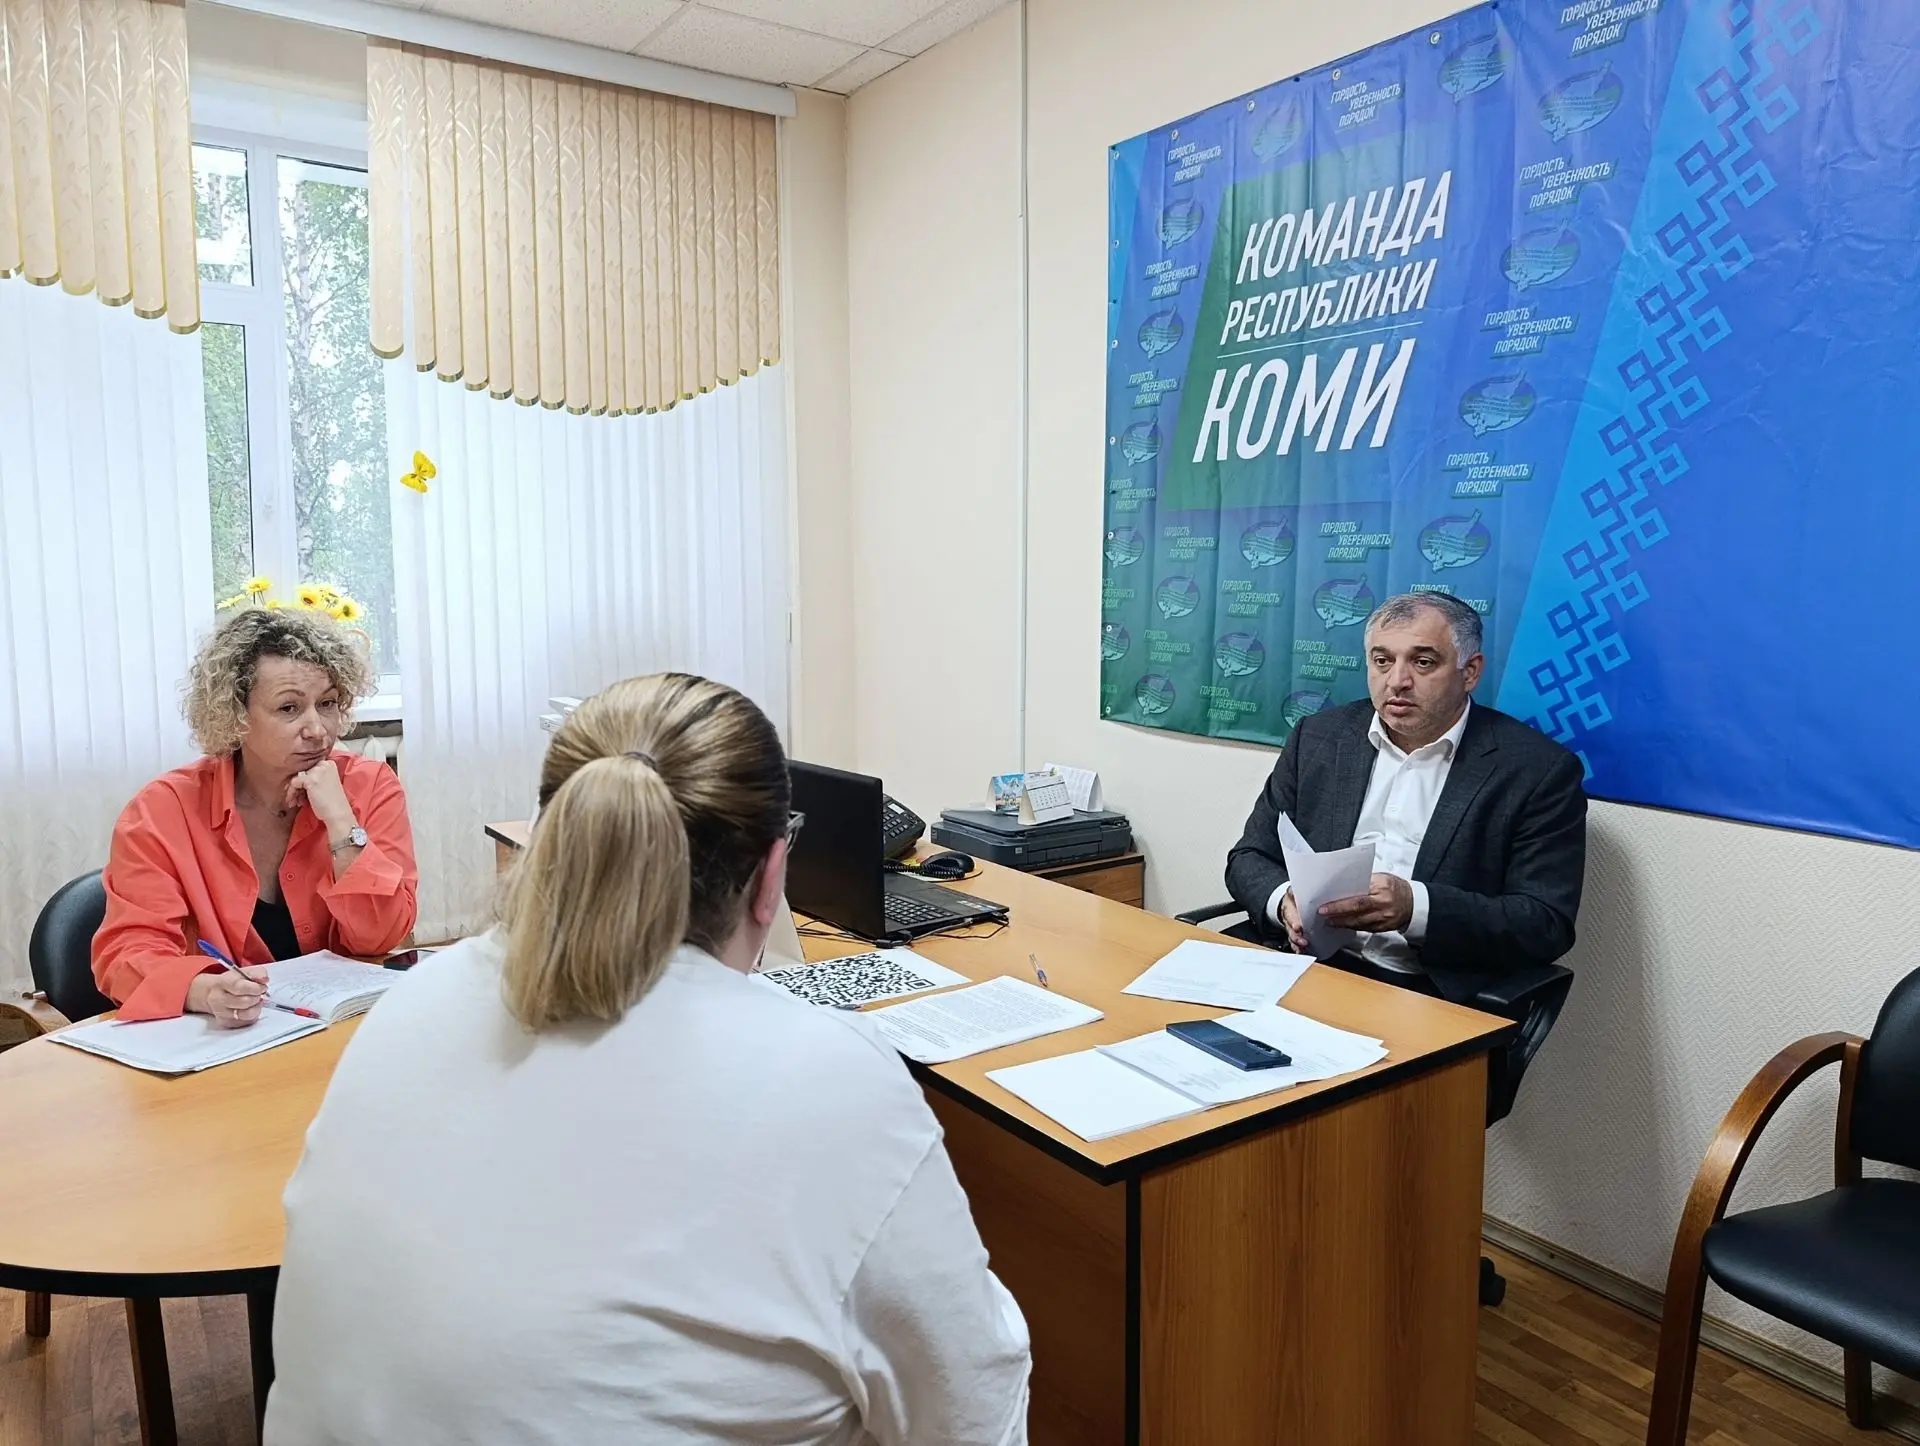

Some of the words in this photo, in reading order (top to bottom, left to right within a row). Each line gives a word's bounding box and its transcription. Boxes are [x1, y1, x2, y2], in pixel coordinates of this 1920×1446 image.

[1572, 23, 1622, 52] ПОРЯДОК
[1330, 81, 1367, 104] ГОРДОСТЬ
[1348, 83, 1401, 111] УВЕРЕННОСТЬ
[1339, 105, 1375, 127] ПОРЯДОК
[1520, 157, 1564, 180] ГОРДОСТЬ
[1541, 162, 1610, 190] УВЕРЕННОСТЬ
[1530, 184, 1576, 208] ПОРЯДОК
[1236, 170, 1451, 284] КОМАНДА
[1220, 258, 1437, 345] РЕСПУБЛИКИ
[1484, 307, 1530, 326] ГОРДОСТЬ
[1507, 315, 1572, 337] УВЕРЕННОСТЬ
[1494, 335, 1540, 353] ПОРЯДОК
[1192, 338, 1416, 463] КОМИ
[1446, 452, 1489, 466] ГОРДОСТЬ
[1467, 463, 1529, 479] УВЕРЕННОСТЬ
[1455, 480, 1499, 494] ПОРЯДОК
[1321, 521, 1357, 534] ГОРДОСТЬ
[1338, 533, 1391, 546] УВЕРЕННОСТЬ
[1328, 547, 1364, 559] ПОРЯДОК
[1293, 640, 1326, 652] ГОРДОСТЬ
[1308, 653, 1357, 667] УВЕРЕННОСТЬ
[1300, 665, 1334, 677] ПОРЯДОК
